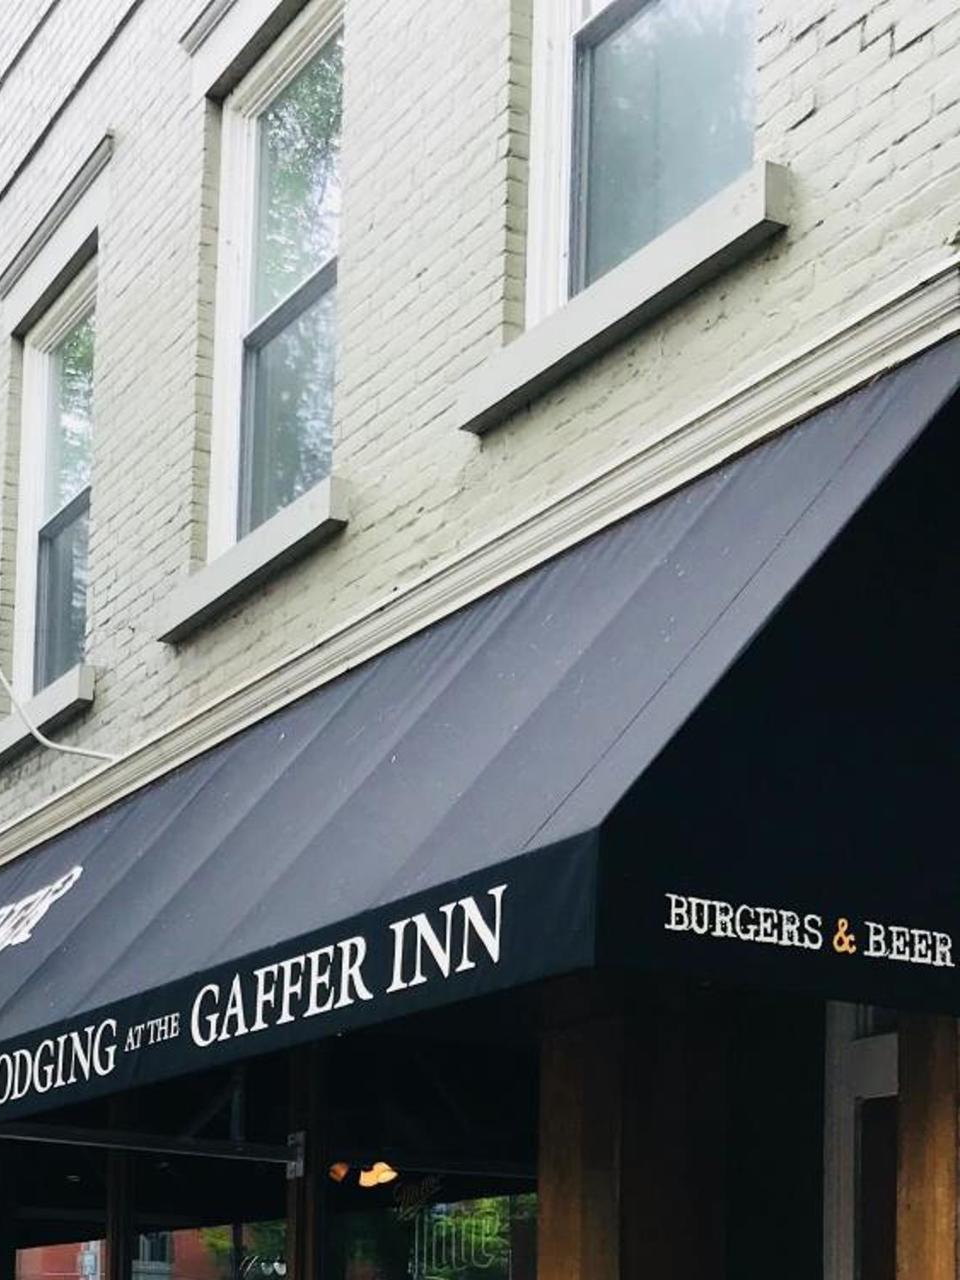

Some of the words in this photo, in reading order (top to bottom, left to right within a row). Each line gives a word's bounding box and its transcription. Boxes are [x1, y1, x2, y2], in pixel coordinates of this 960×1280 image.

[124, 1023, 145, 1052] AT
[146, 1011, 180, 1044] THE
[190, 935, 374, 1048] GAFFER
[385, 883, 508, 996] INN
[664, 893, 823, 950] BURGERS
[832, 917, 857, 954] &
[864, 920, 956, 967] BEER
